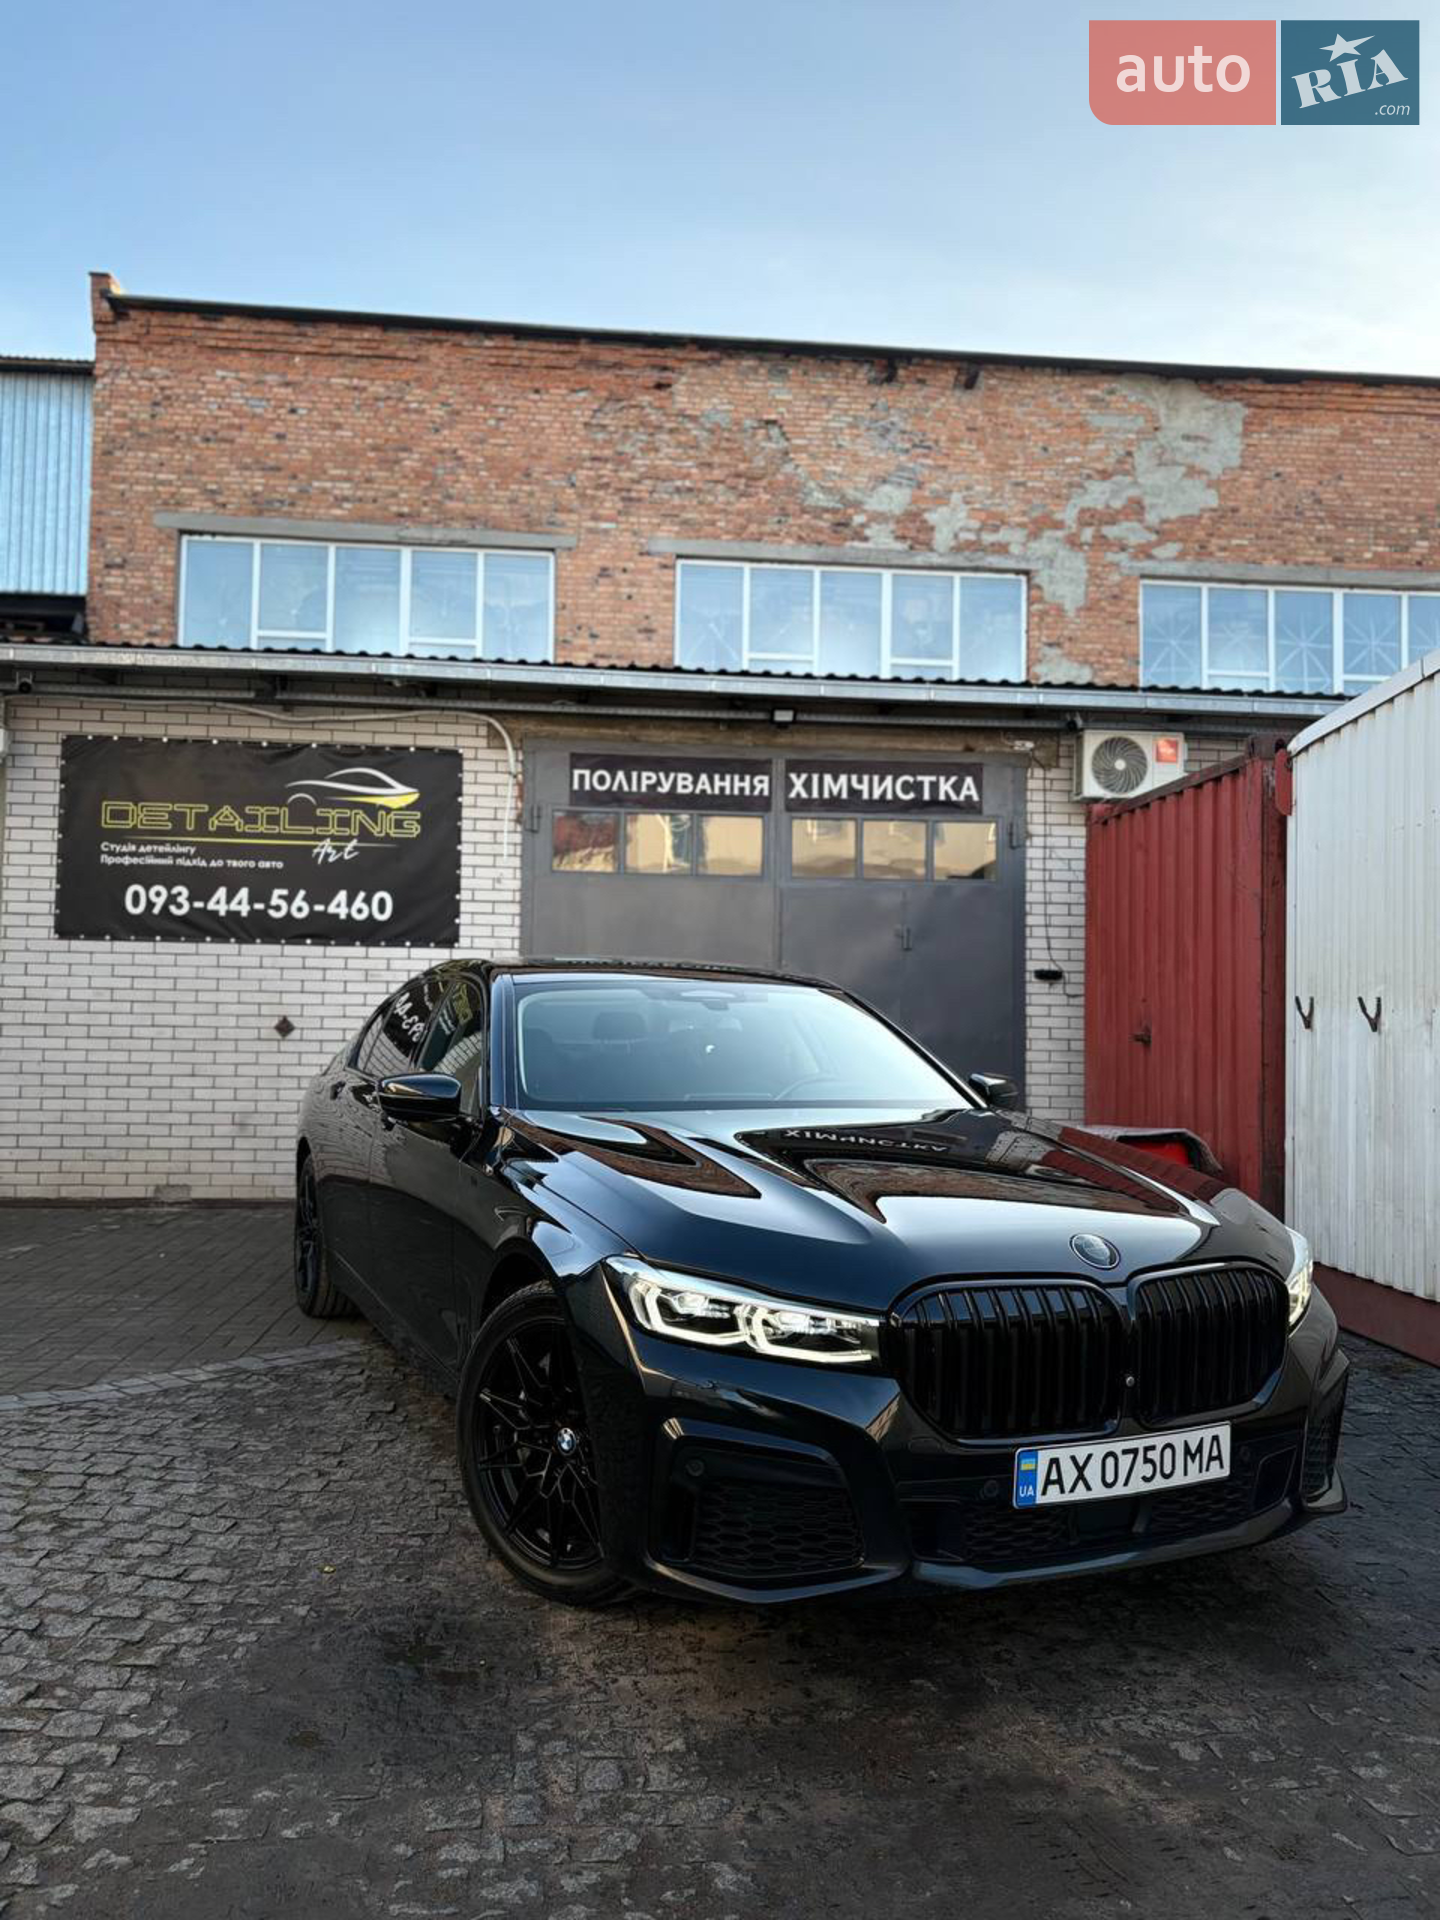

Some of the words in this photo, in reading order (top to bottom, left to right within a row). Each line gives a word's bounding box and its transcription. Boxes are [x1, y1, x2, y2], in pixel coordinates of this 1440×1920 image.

[572, 768, 770, 797] ПОЛІРУВАННЯ
[788, 772, 980, 802] ХІМЧИСТКА
[101, 800, 421, 838] DETAILING
[100, 841, 136, 854] Студія
[311, 837, 360, 865] Art
[209, 858, 224, 868] до
[124, 883, 394, 922] 093-44-56-460
[1041, 1453, 1094, 1496] AX
[1101, 1443, 1176, 1489] 0750
[1183, 1434, 1225, 1477] MA
[1019, 1485, 1035, 1498] UA
